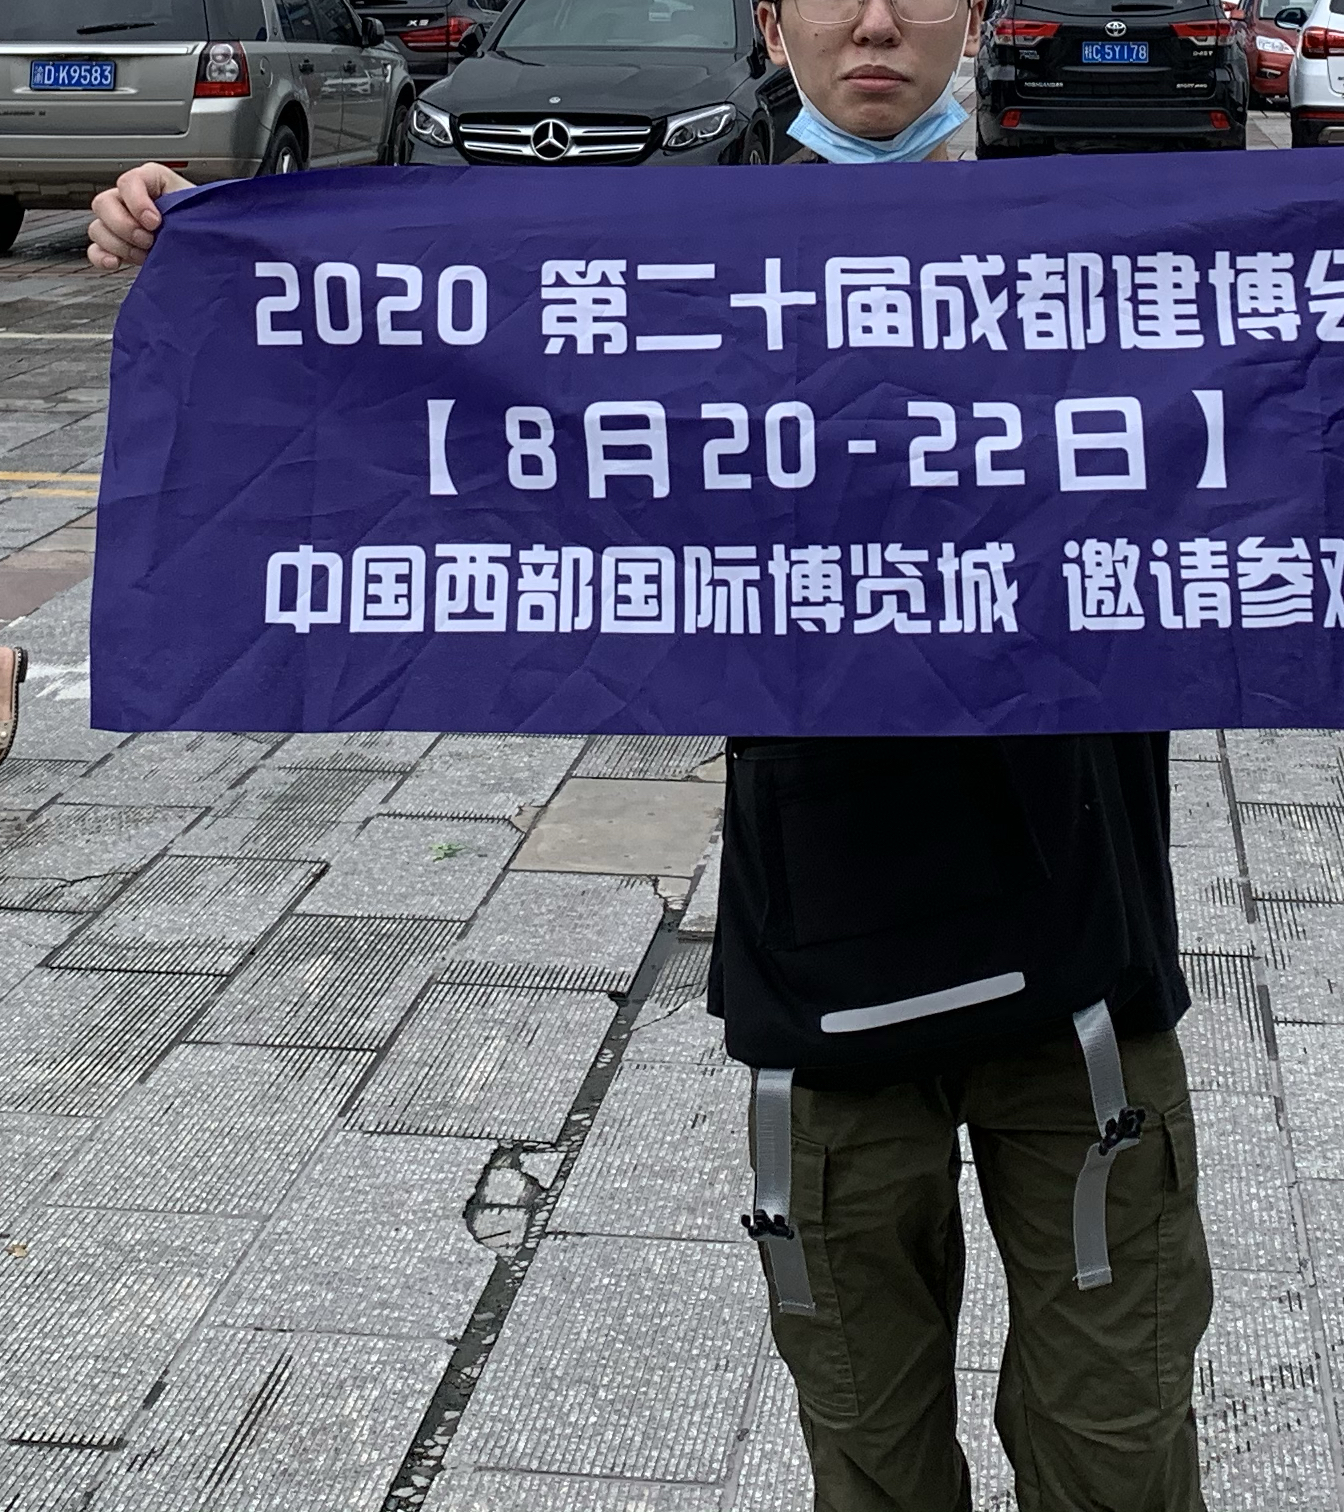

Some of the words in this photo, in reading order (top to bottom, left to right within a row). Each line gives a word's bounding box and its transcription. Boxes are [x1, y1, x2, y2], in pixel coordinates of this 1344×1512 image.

[254, 258, 488, 348] 2020
[263, 538, 1019, 638] 中国西部国际博览城
